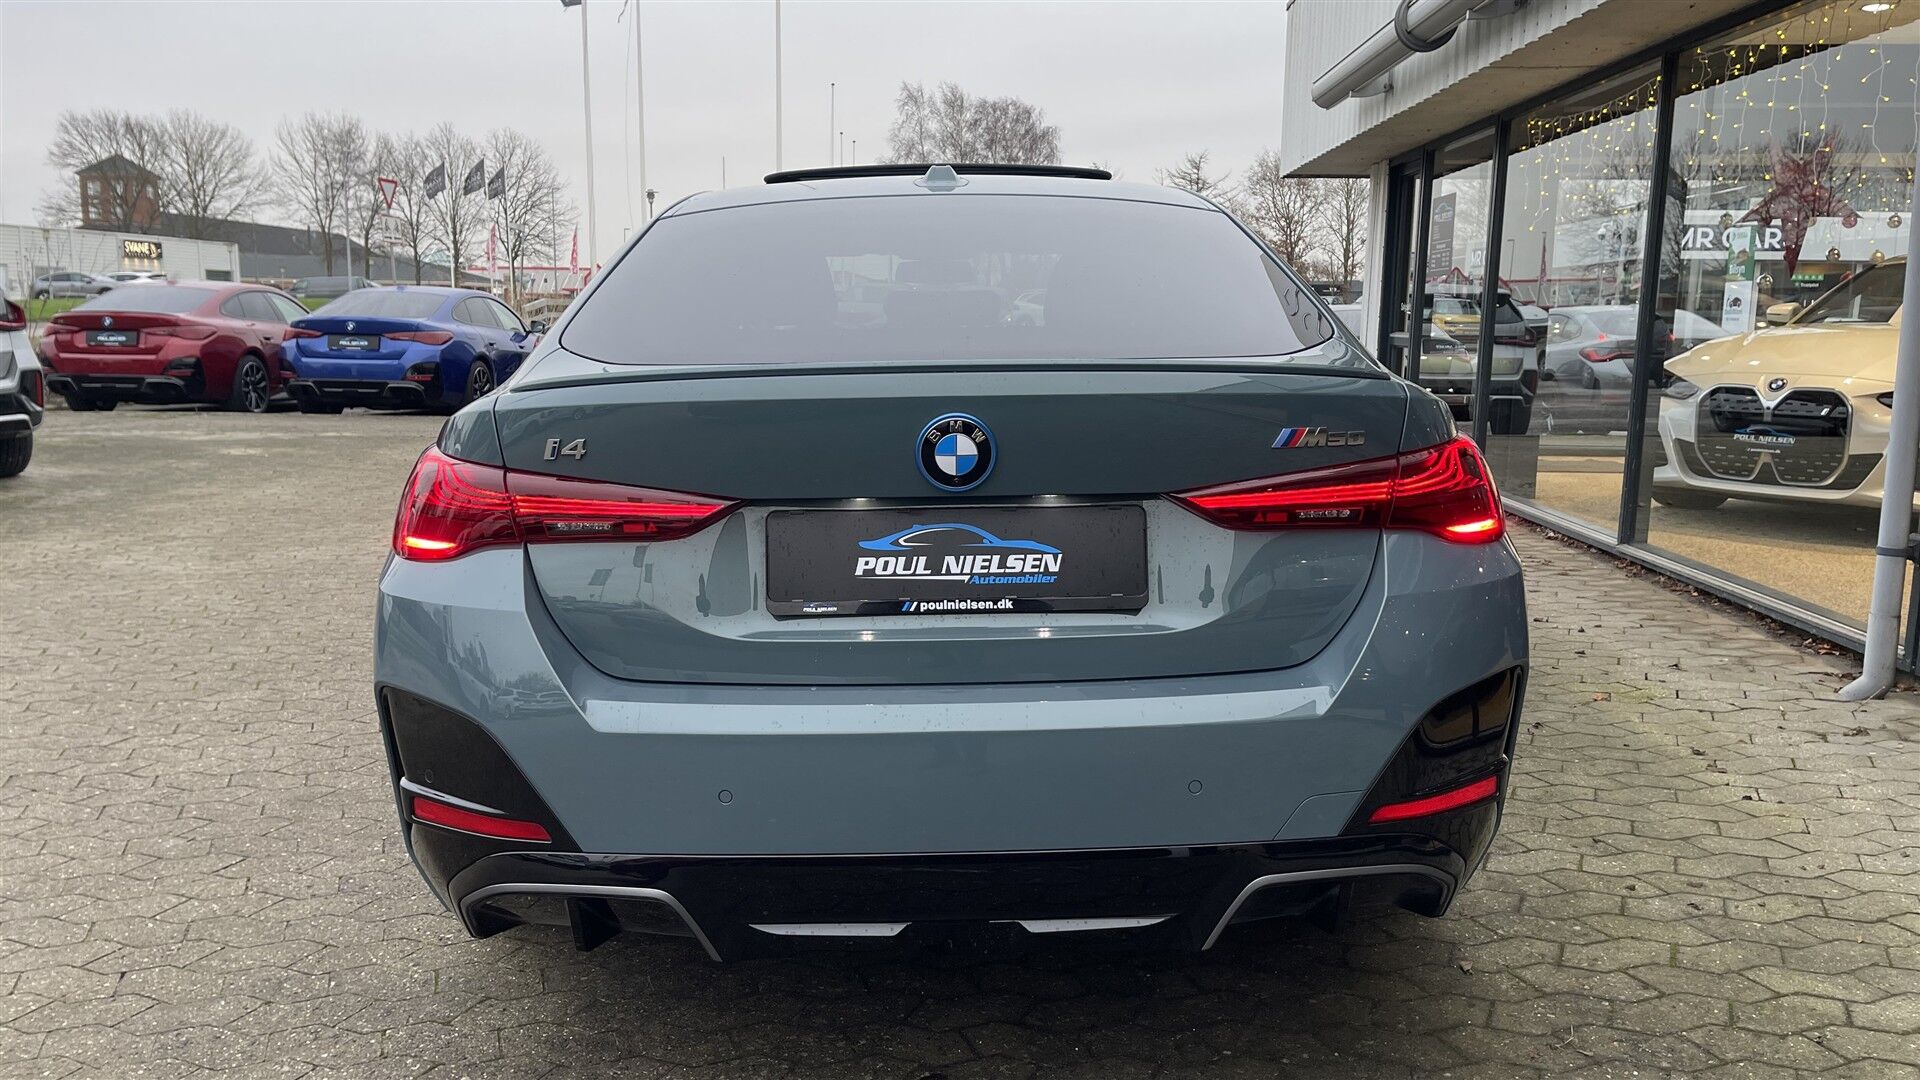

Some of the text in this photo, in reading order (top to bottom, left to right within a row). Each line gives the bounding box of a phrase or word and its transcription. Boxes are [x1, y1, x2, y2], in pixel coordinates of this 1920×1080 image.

[927, 420, 987, 444] BMW
[1295, 426, 1366, 448] M50
[1733, 433, 1756, 441] POUL
[1758, 435, 1796, 444] NIELSEN
[543, 438, 587, 461] i4
[854, 553, 1063, 576] POUL NIELSEN
[969, 574, 1058, 585] Automobiler
[919, 599, 1014, 613] poulnielsen.dk
